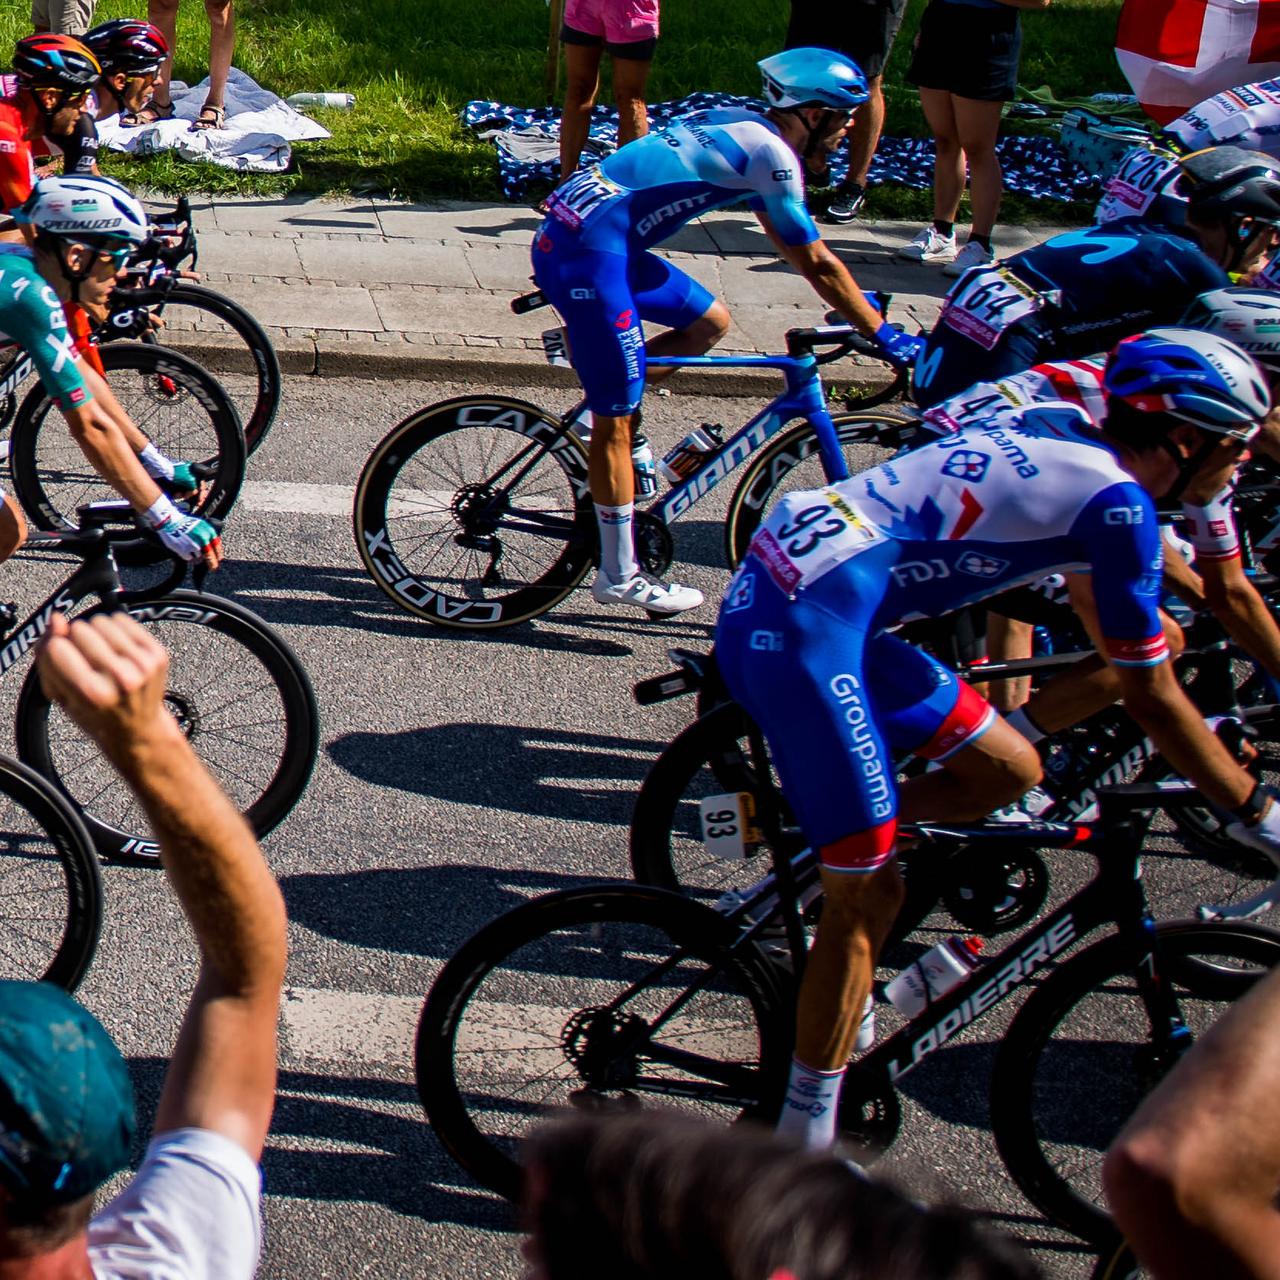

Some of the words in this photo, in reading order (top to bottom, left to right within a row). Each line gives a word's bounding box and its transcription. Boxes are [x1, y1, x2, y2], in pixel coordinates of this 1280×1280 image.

[42, 217, 123, 231] SPECIALIZED
[635, 191, 713, 238] GIANT
[964, 280, 1026, 321] 64
[542, 332, 567, 360] 207
[617, 331, 641, 381] EXCHANGE
[664, 411, 781, 527] GIANT
[777, 503, 848, 559] 93
[363, 527, 505, 624] CADEX
[889, 558, 952, 589] FDJ
[829, 673, 893, 819] Groupama
[704, 809, 739, 839] 93
[886, 913, 1078, 1082] LAPIERRE
